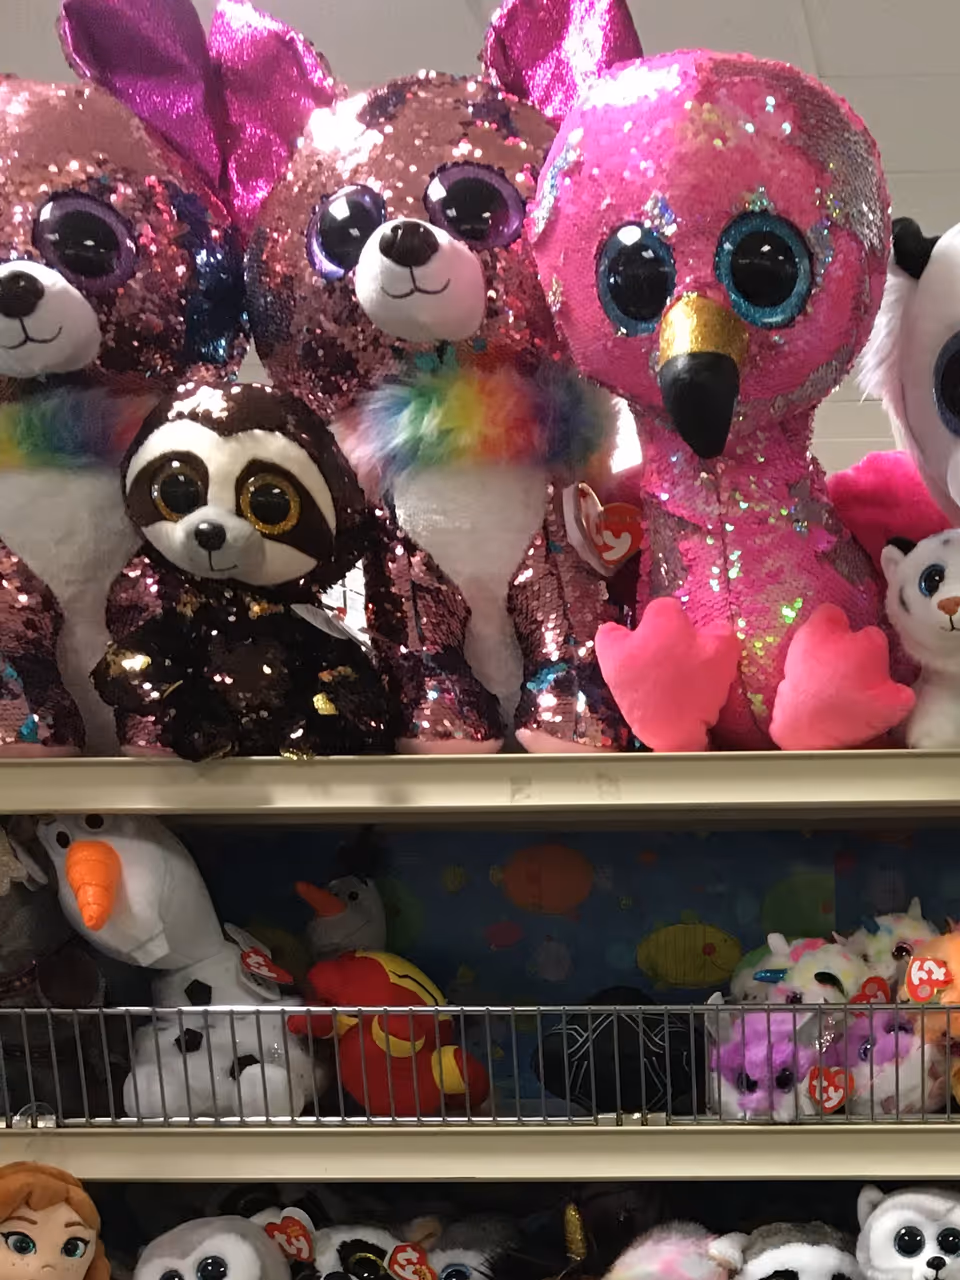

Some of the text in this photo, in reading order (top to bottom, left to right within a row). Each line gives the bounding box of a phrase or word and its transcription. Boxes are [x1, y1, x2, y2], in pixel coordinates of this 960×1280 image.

[246, 953, 278, 977] ty
[911, 960, 947, 985] ty
[812, 1076, 844, 1108] ty
[274, 1231, 309, 1259] ty
[394, 1247, 420, 1280] ty
